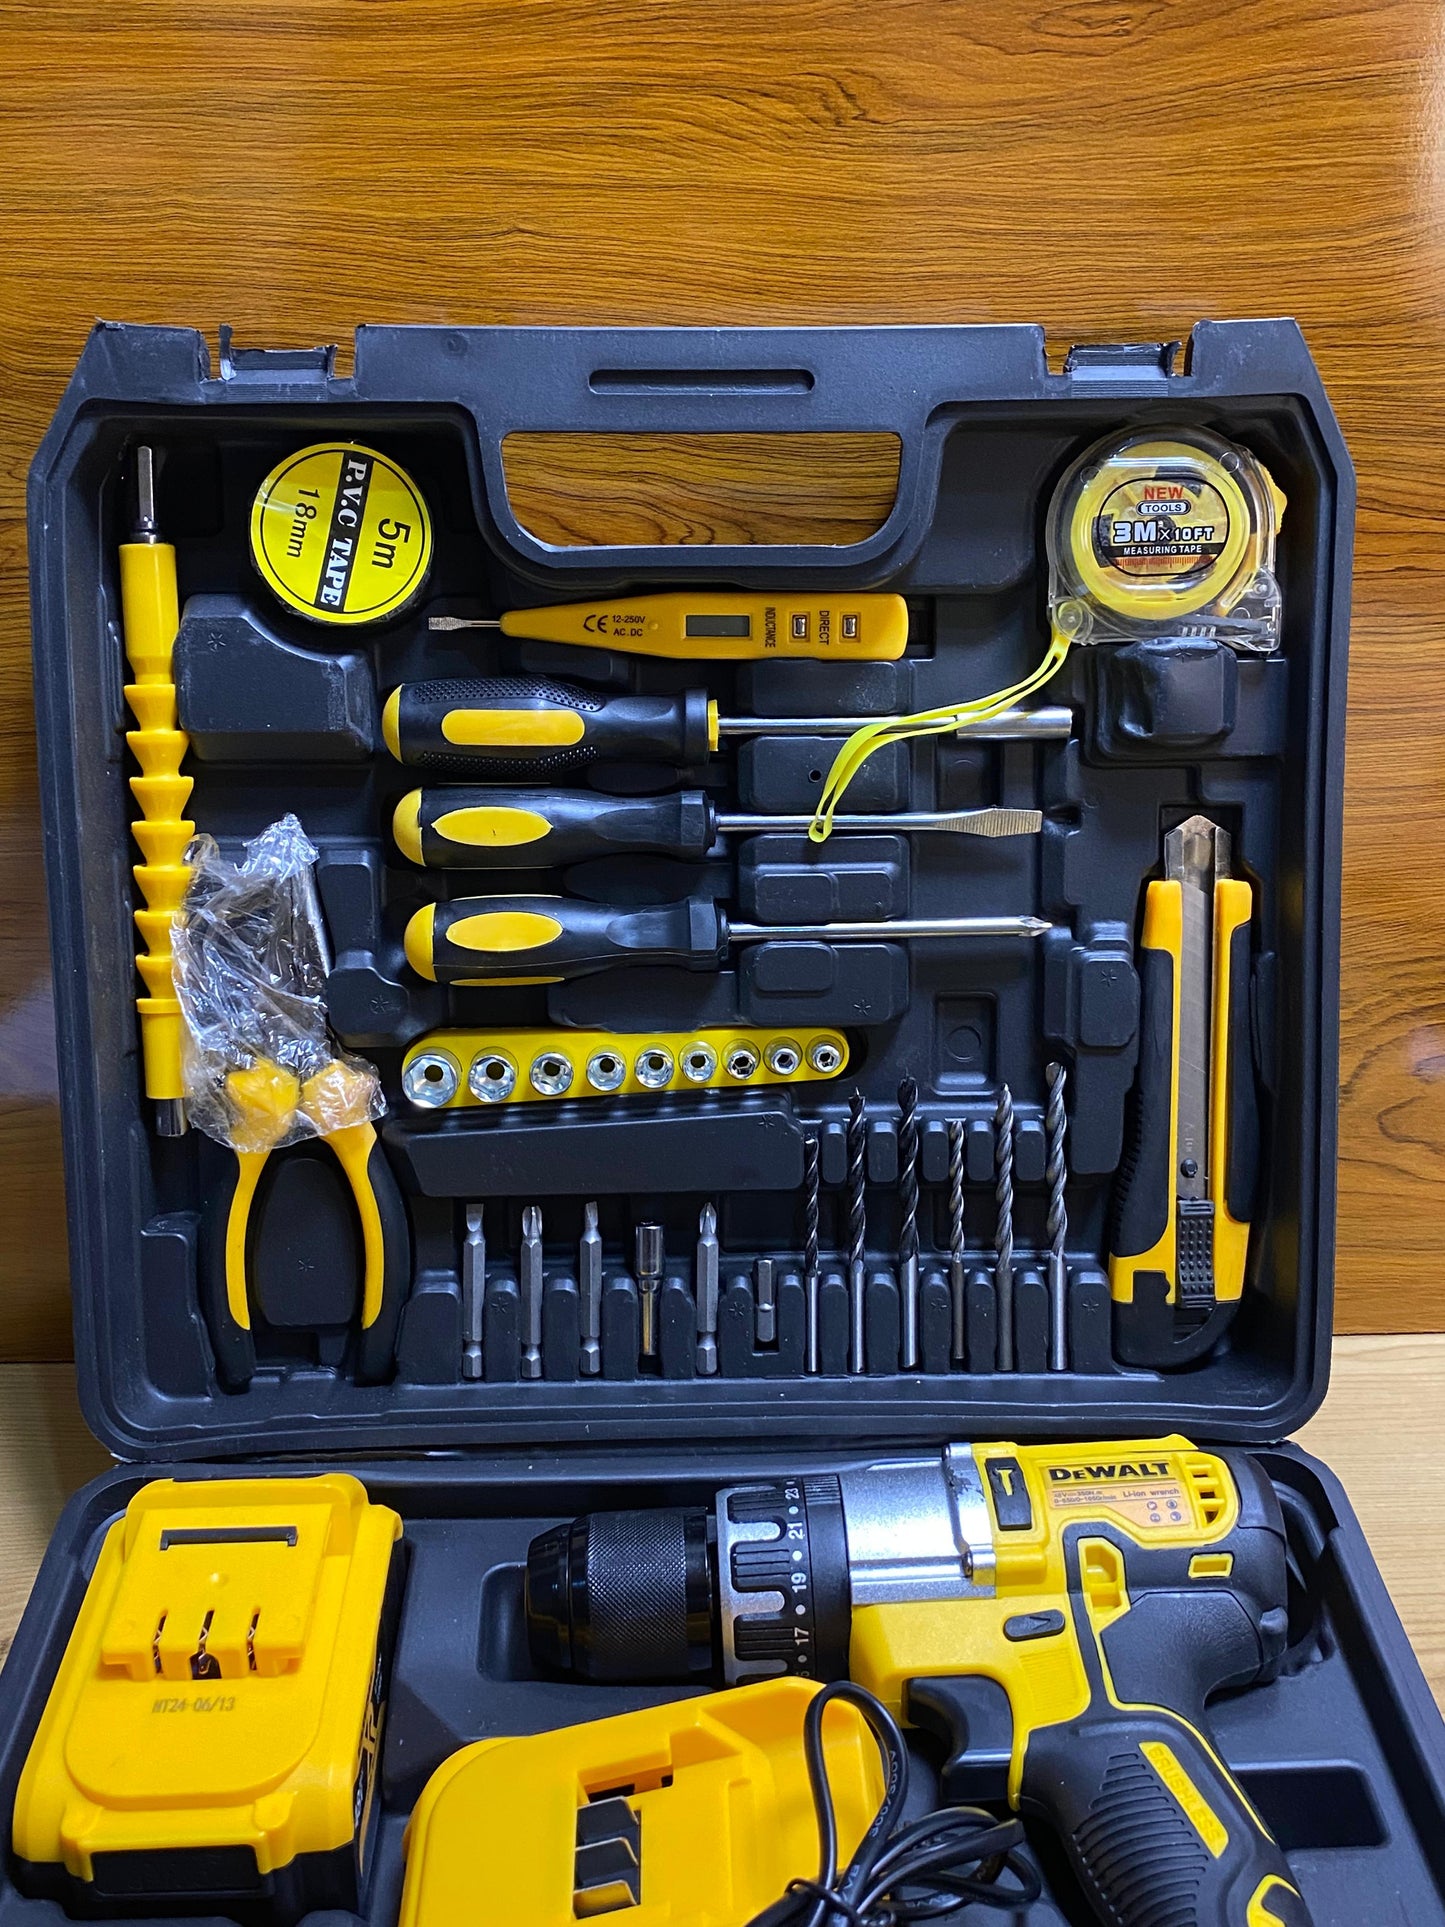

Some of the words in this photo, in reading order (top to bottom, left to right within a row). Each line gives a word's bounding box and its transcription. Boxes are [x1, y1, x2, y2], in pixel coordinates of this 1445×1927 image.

[337, 459, 368, 528] P.V.C
[1144, 486, 1184, 500] NEW
[1145, 504, 1182, 513] TOOLS
[286, 488, 321, 558] 18mm
[371, 518, 412, 569] 5m
[1123, 545, 1178, 555] MEASURING
[1179, 544, 1202, 554] TAPE
[321, 537, 353, 606] TAPE
[612, 614, 646, 625] 12-250V
[764, 607, 776, 648] INDUCTANCE
[819, 610, 830, 645] DIRECT
[785, 1487, 800, 1500] 23
[1150, 1487, 1180, 1497] wrench
[788, 1522, 804, 1540] 21
[791, 1572, 807, 1593] 19
[794, 1627, 810, 1646] 17
[870, 1750, 899, 1838] 300/300V
